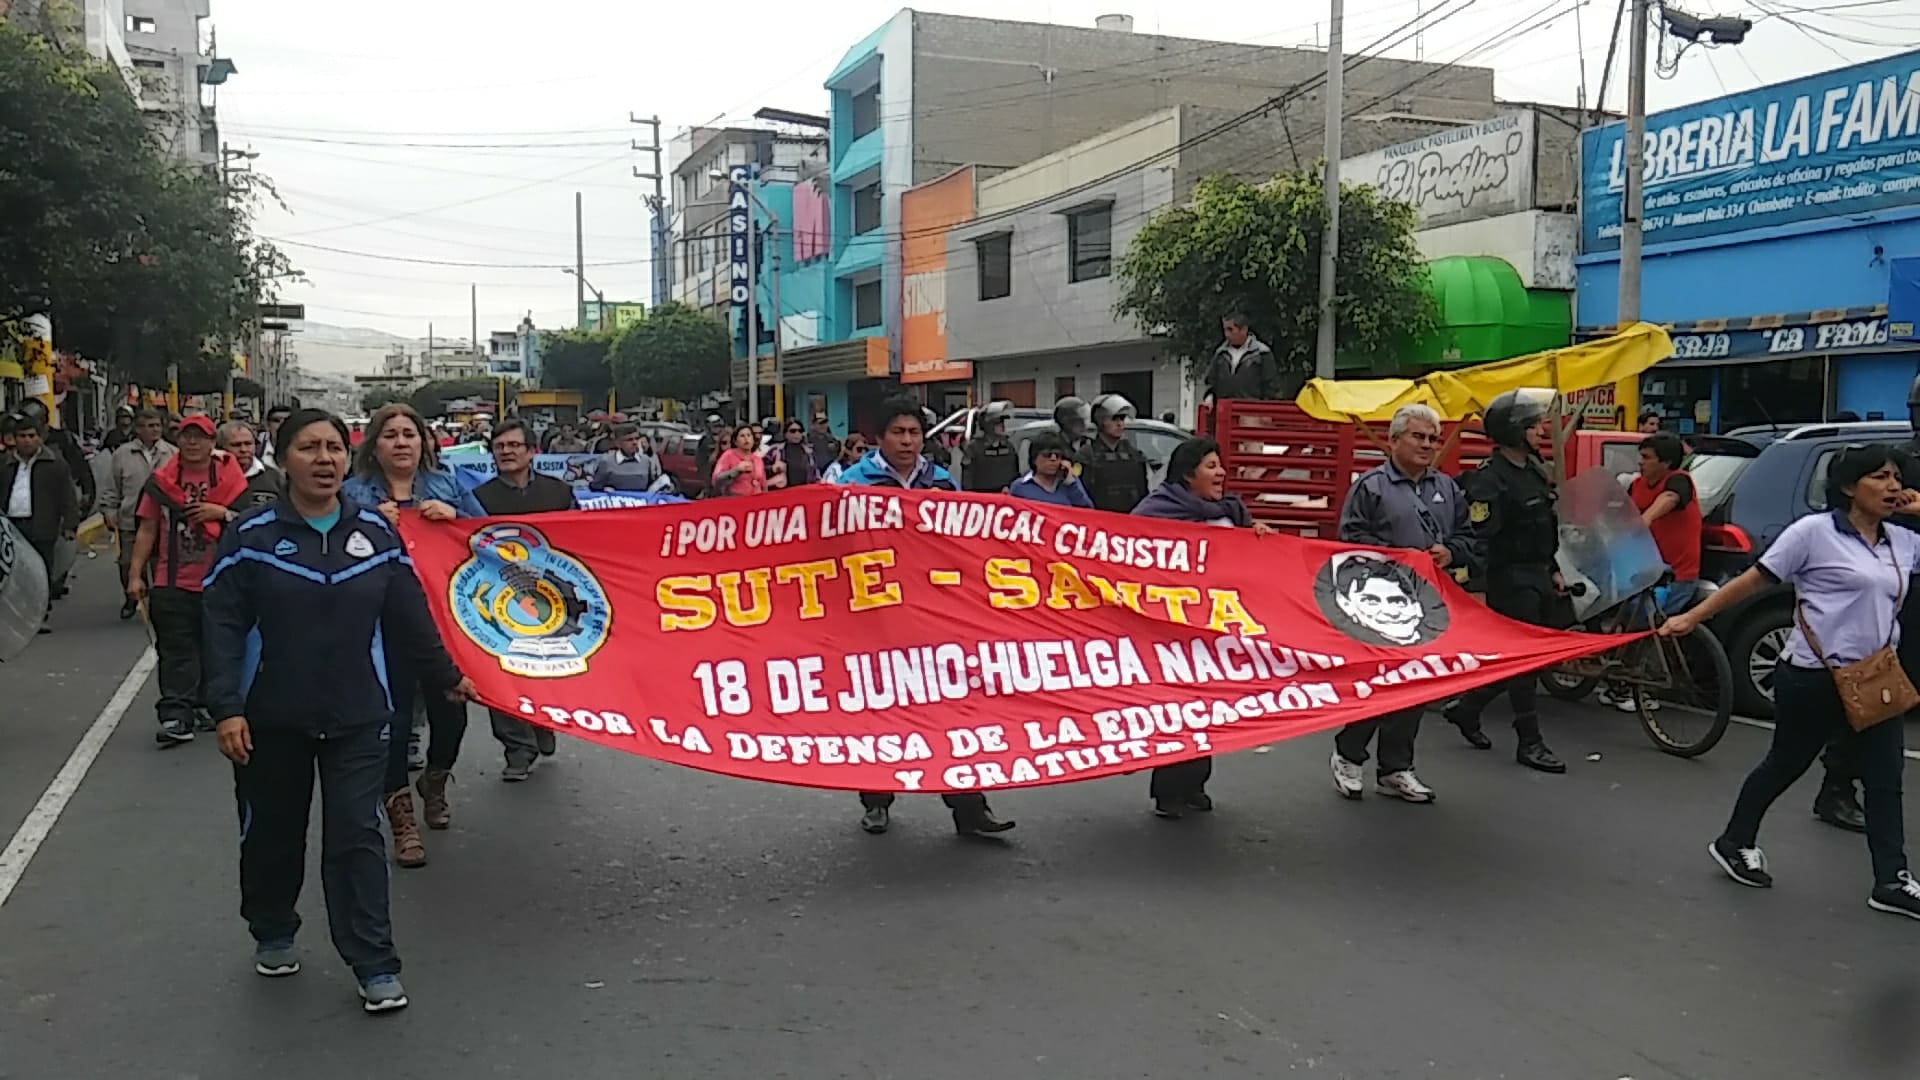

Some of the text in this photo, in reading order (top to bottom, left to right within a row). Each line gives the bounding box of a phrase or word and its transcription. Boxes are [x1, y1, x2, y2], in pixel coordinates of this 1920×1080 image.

[1609, 108, 1756, 187] LBRERIA
[1759, 96, 1810, 165] LA
[1816, 68, 1920, 153] FAM
[1824, 165, 1833, 181] y
[1834, 156, 1875, 178] regalos
[1876, 150, 1905, 172] para
[731, 167, 749, 303] CASINO
[1567, 388, 1615, 406] OPICA
[660, 515, 737, 557] ¡POR
[744, 504, 808, 548] UNA
[820, 490, 903, 538] LÍNEA
[916, 499, 1046, 546] SINDICAL
[656, 548, 903, 632] SUTE
[984, 557, 1267, 637] SANTA
[692, 659, 751, 717] 18
[765, 655, 830, 714] DE
[649, 717, 713, 754] LA
[726, 731, 933, 765] DEFENSA
[946, 724, 1009, 759] DE
[1023, 716, 1086, 750] LA
[1092, 680, 1341, 743] EDUCACIÓN
[895, 769, 924, 790] Y
